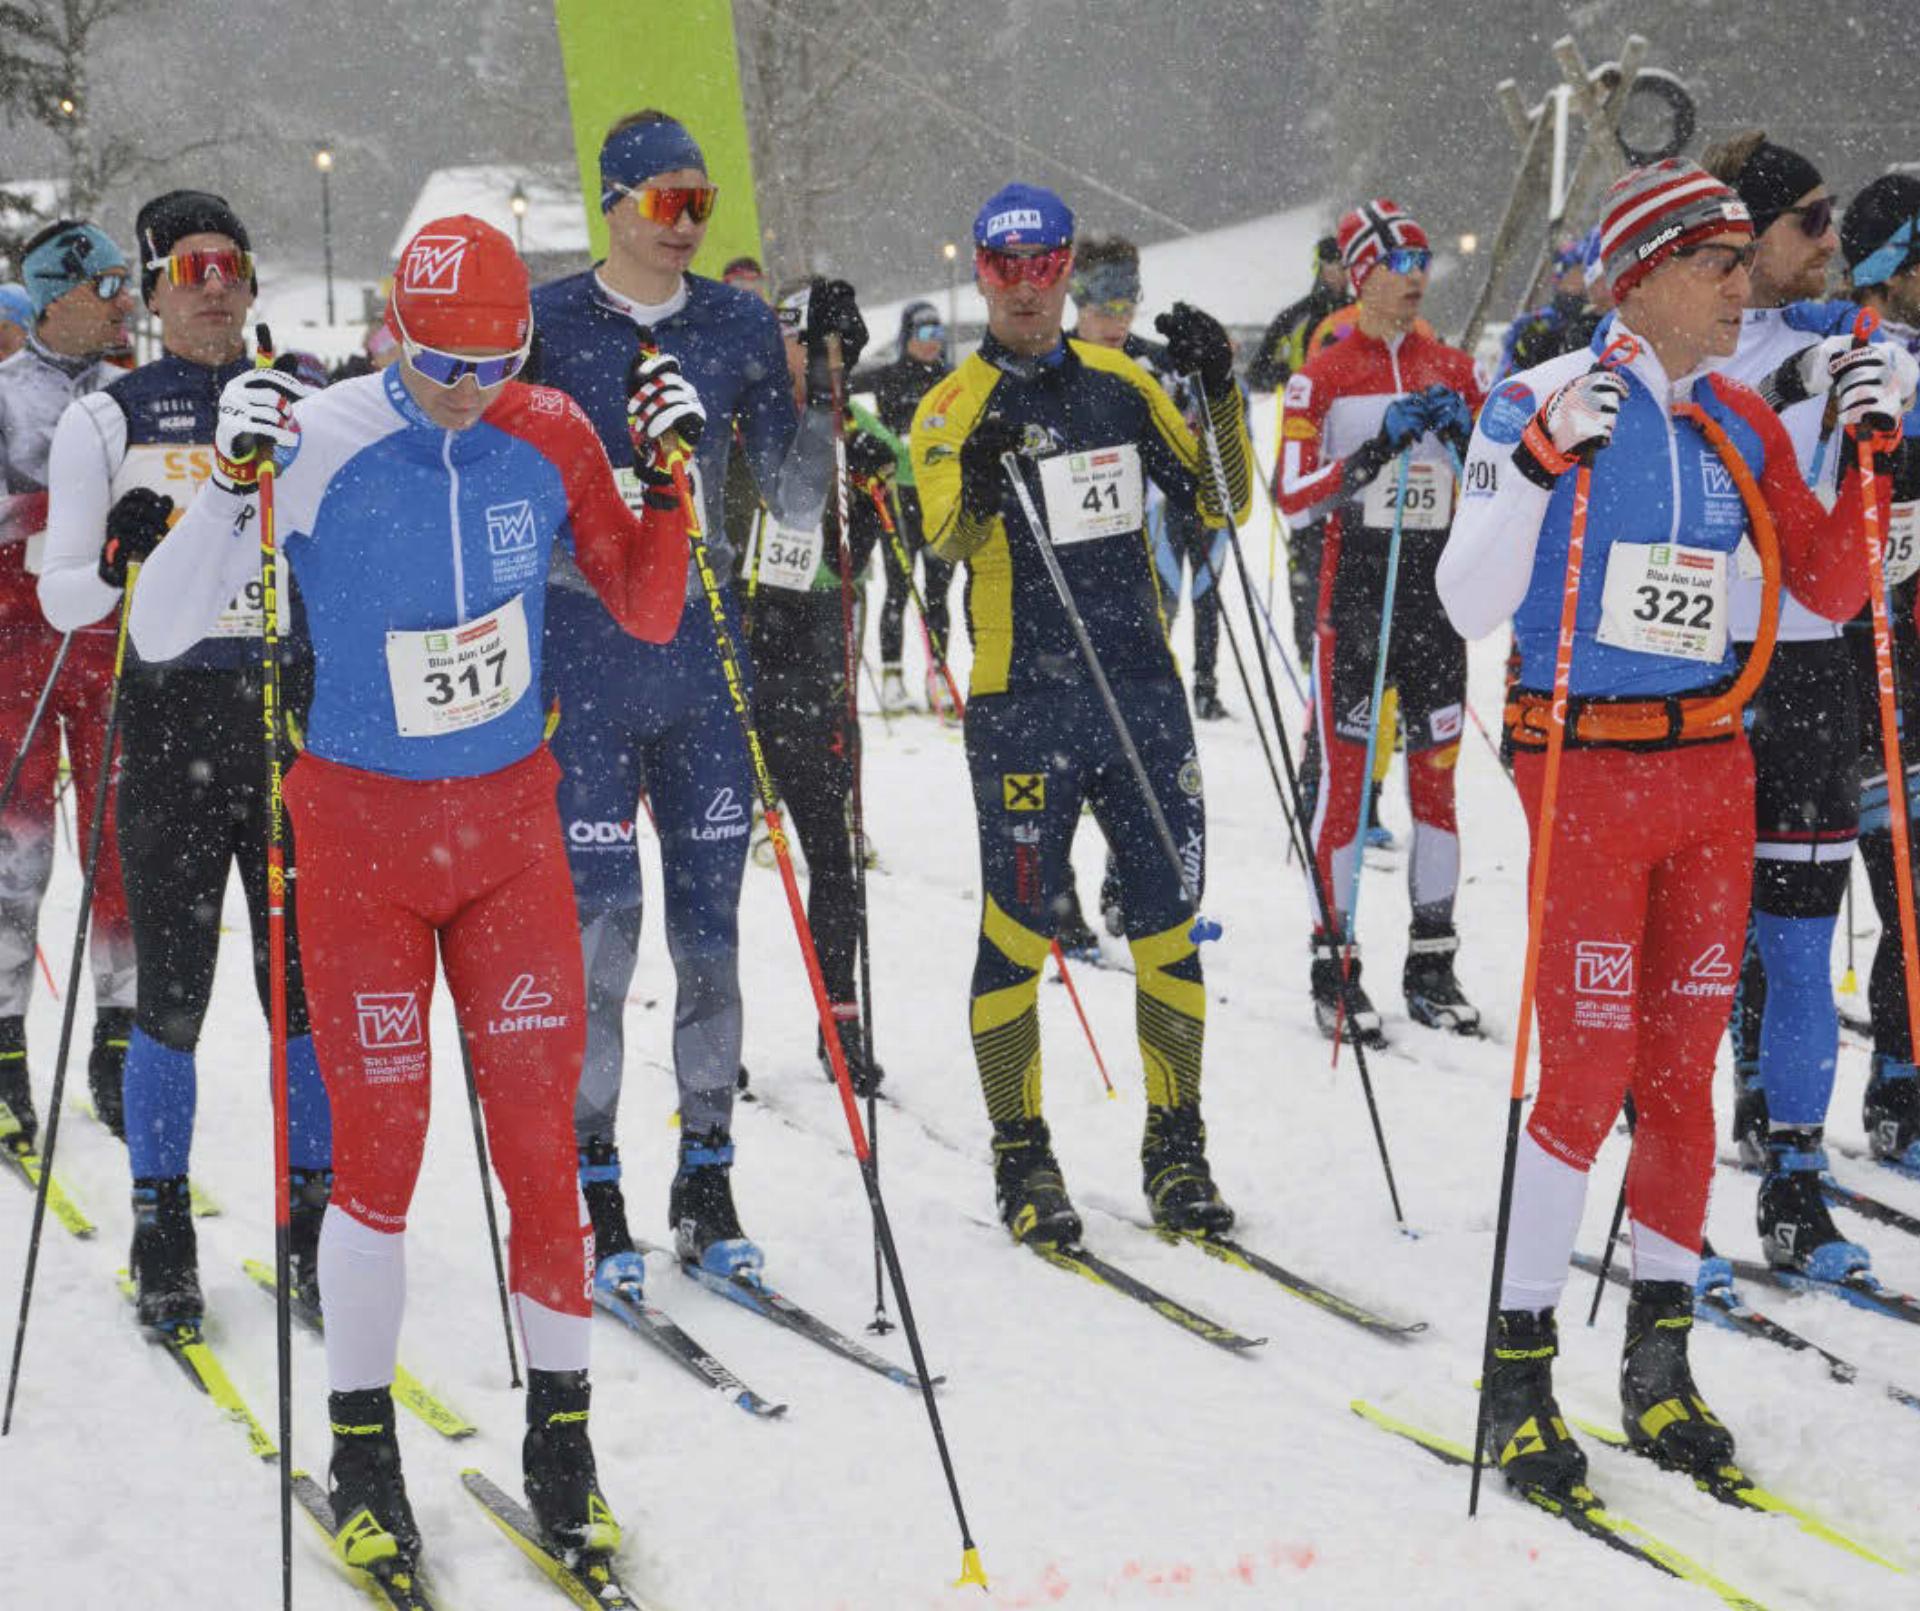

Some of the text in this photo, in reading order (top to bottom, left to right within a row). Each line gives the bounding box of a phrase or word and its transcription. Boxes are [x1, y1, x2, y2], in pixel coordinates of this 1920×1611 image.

[1082, 481, 1120, 513] 41
[1385, 486, 1436, 510] 205
[767, 542, 811, 571] 346
[1633, 585, 1714, 631] 322
[423, 648, 508, 707] 317
[488, 1014, 569, 1034] Löffler
